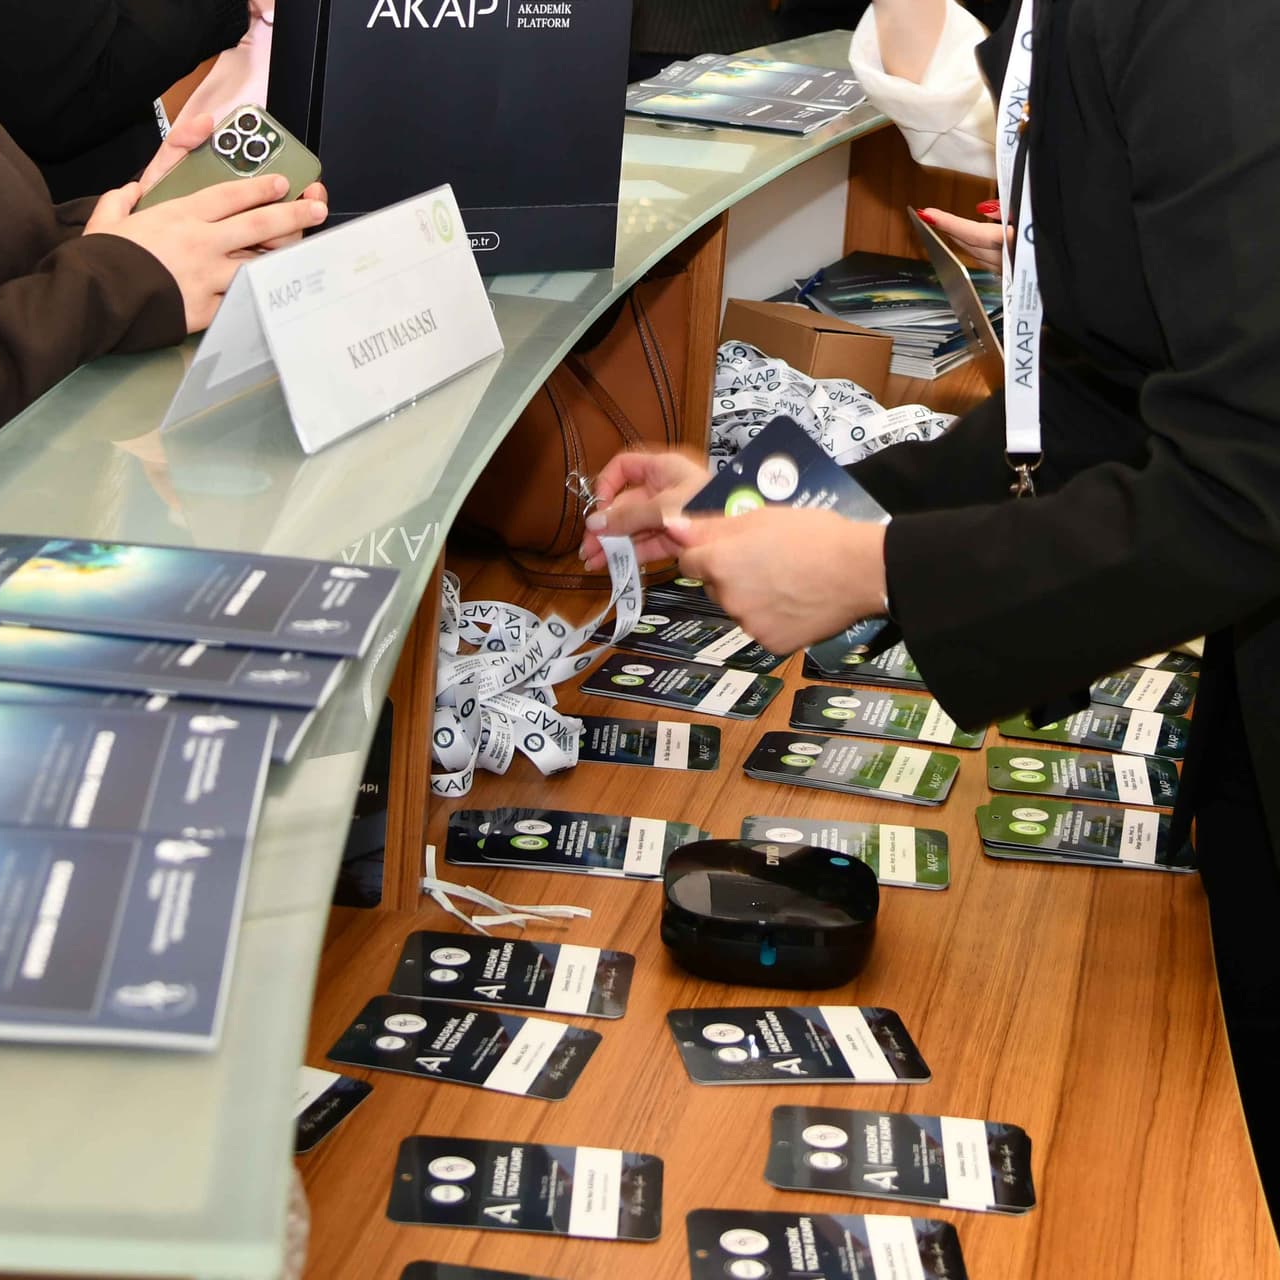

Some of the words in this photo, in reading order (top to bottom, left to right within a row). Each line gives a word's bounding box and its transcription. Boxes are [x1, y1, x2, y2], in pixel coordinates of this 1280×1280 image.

[518, 3, 572, 15] AKADEMİK
[517, 17, 570, 28] PLATFORM
[1004, 76, 1029, 146] AKAP
[470, 237, 490, 248] p.tr
[268, 279, 303, 311] AKAP
[346, 330, 390, 370] KAYIT
[388, 308, 438, 352] MASASI
[1015, 320, 1034, 389] AKAP
[732, 370, 777, 387] AKAP
[502, 640, 544, 685] AKAP
[358, 783, 379, 794] MPI
[430, 771, 472, 794] KAP
[926, 853, 938, 871] AKAP
[480, 947, 501, 979] AKADEMİK
[498, 941, 516, 961] KAMPI
[493, 961, 509, 980] YAZIM
[428, 1016, 462, 1050] AKADEMİK
[441, 1030, 466, 1052] YAZIM
[455, 1012, 480, 1032] KAMPI
[762, 1010, 783, 1032] KAMPI
[755, 1018, 781, 1052] AKADEMİK
[773, 1032, 793, 1052] YAZIM
[878, 1116, 892, 1139] KAMPI
[862, 1123, 882, 1163] AKADEMİK
[878, 1140, 892, 1164] YAZIM
[509, 1147, 524, 1171] KAMPI
[490, 1155, 509, 1196] AKADEMİK
[505, 1171, 521, 1196] YAZIM
[797, 1217, 817, 1244] KAMPI
[783, 1226, 806, 1270] AKADEMİK
[803, 1245, 821, 1270] YAZIM
